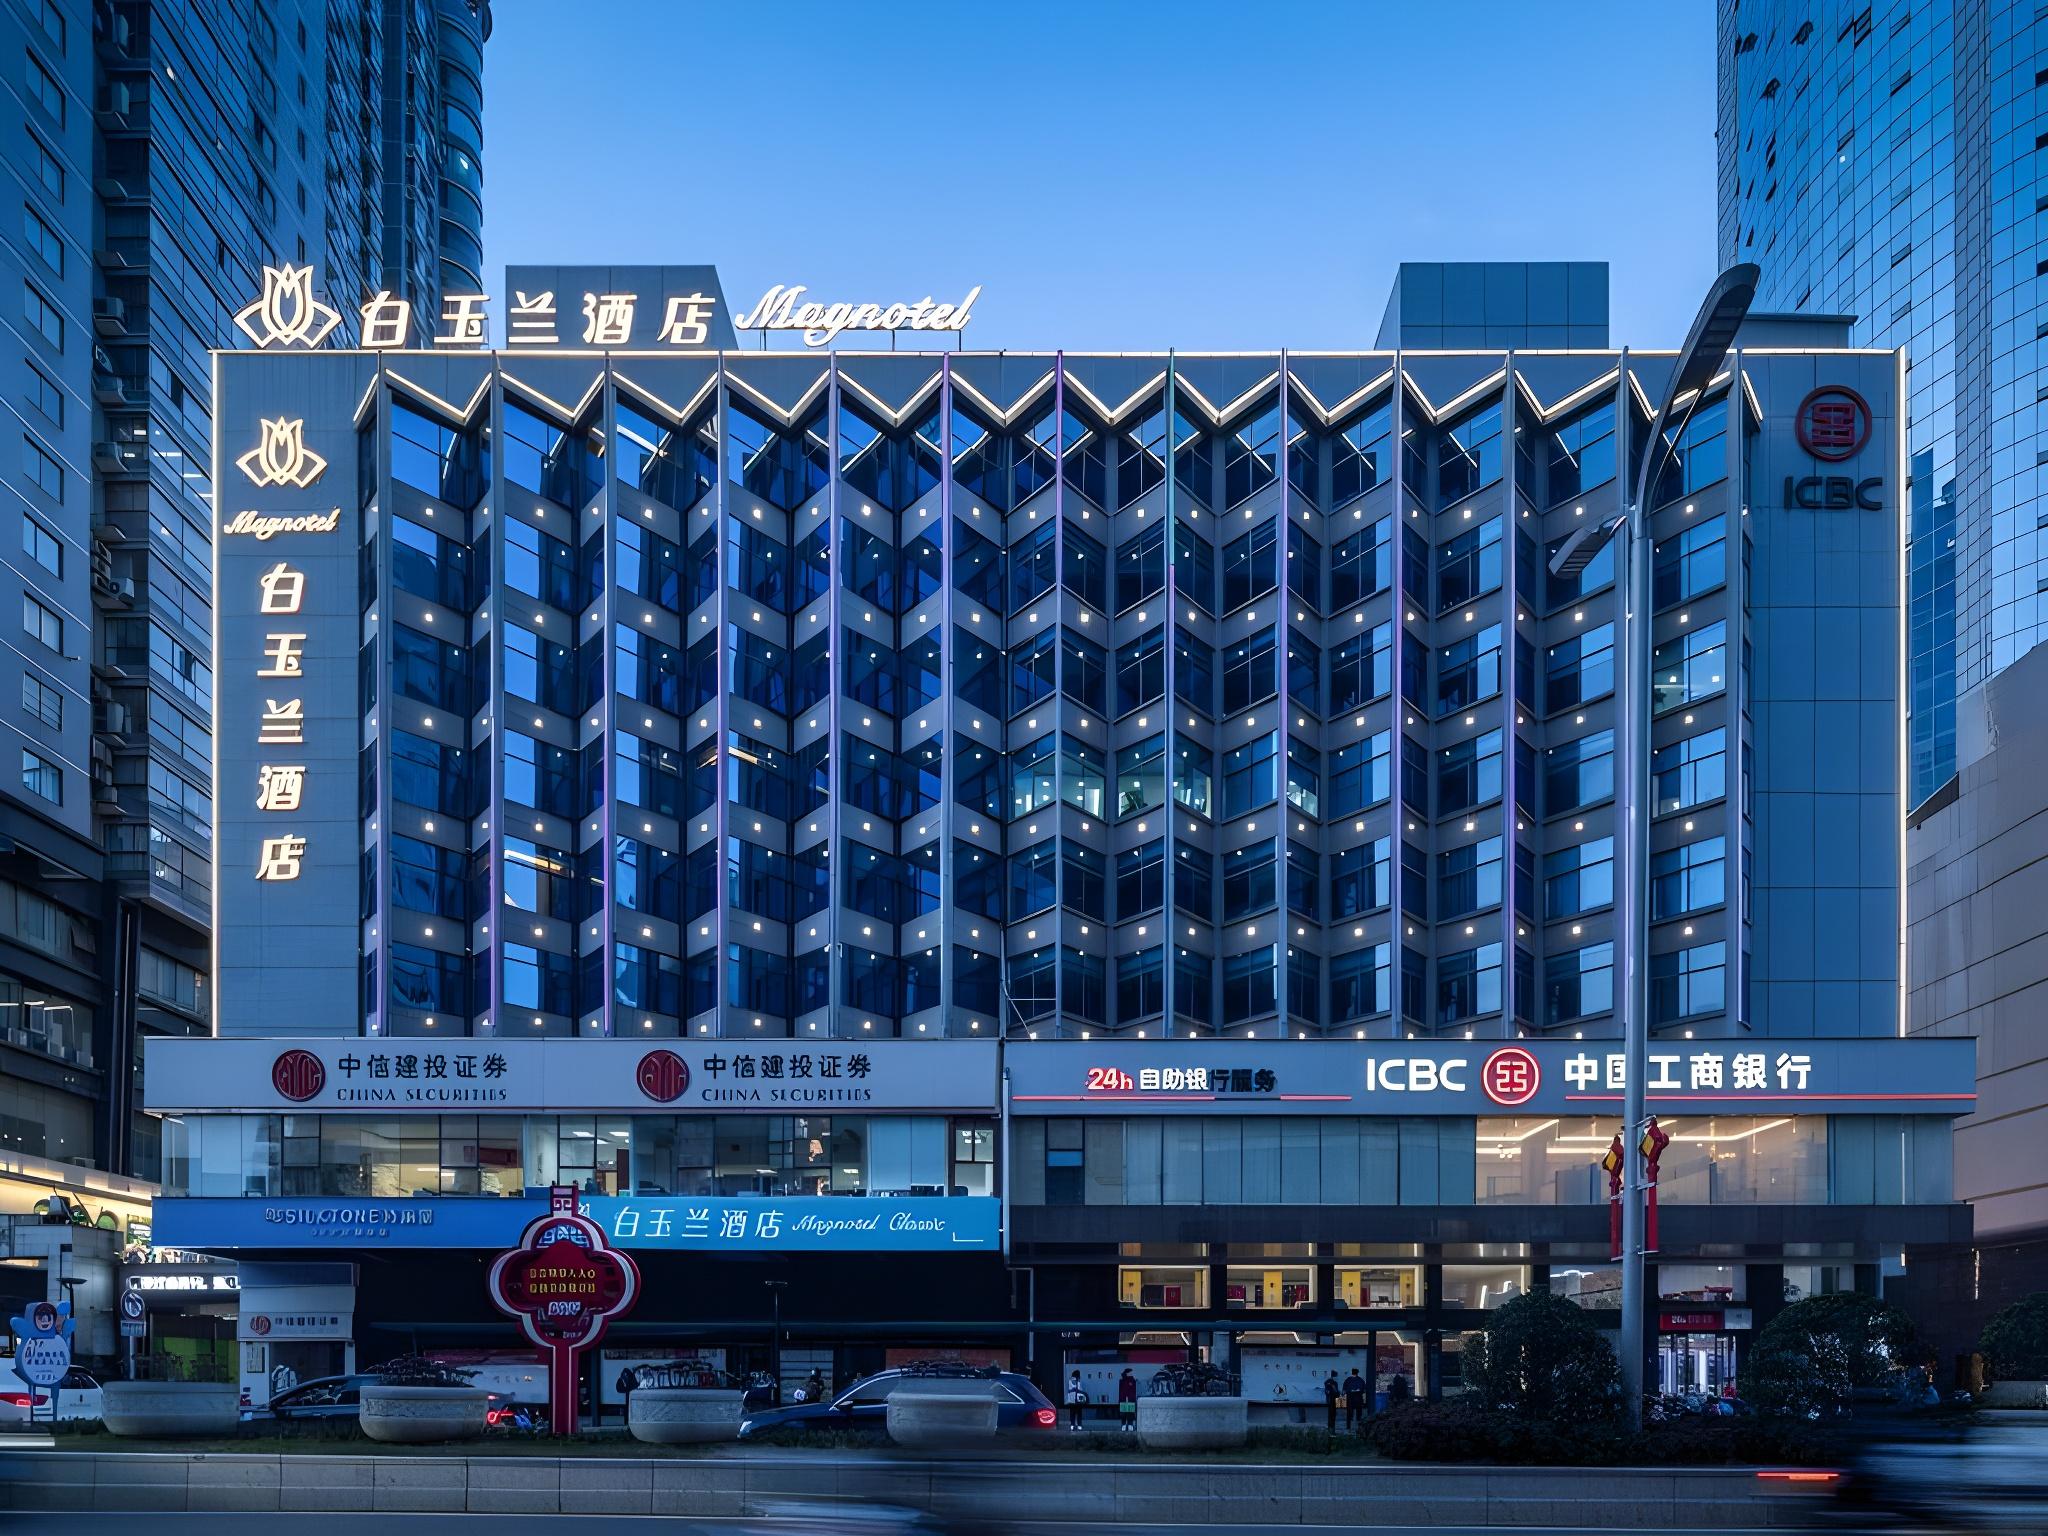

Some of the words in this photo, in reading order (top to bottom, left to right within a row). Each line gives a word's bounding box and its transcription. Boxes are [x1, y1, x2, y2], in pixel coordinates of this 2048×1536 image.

[360, 291, 717, 347] 白玉兰酒店
[735, 284, 982, 347] Magnotel
[1784, 476, 1883, 511] ICBC
[223, 508, 341, 541] Magnotel
[256, 563, 307, 881] 白玉兰酒店
[338, 1053, 508, 1079] 中信建投证券
[703, 1053, 871, 1080] 中信建投证券
[1087, 1067, 1134, 1091] 24h
[1366, 1058, 1468, 1091] ICBC
[1564, 1052, 1812, 1091] 中国工商银行
[613, 1206, 784, 1239] 白玉兰酒店
